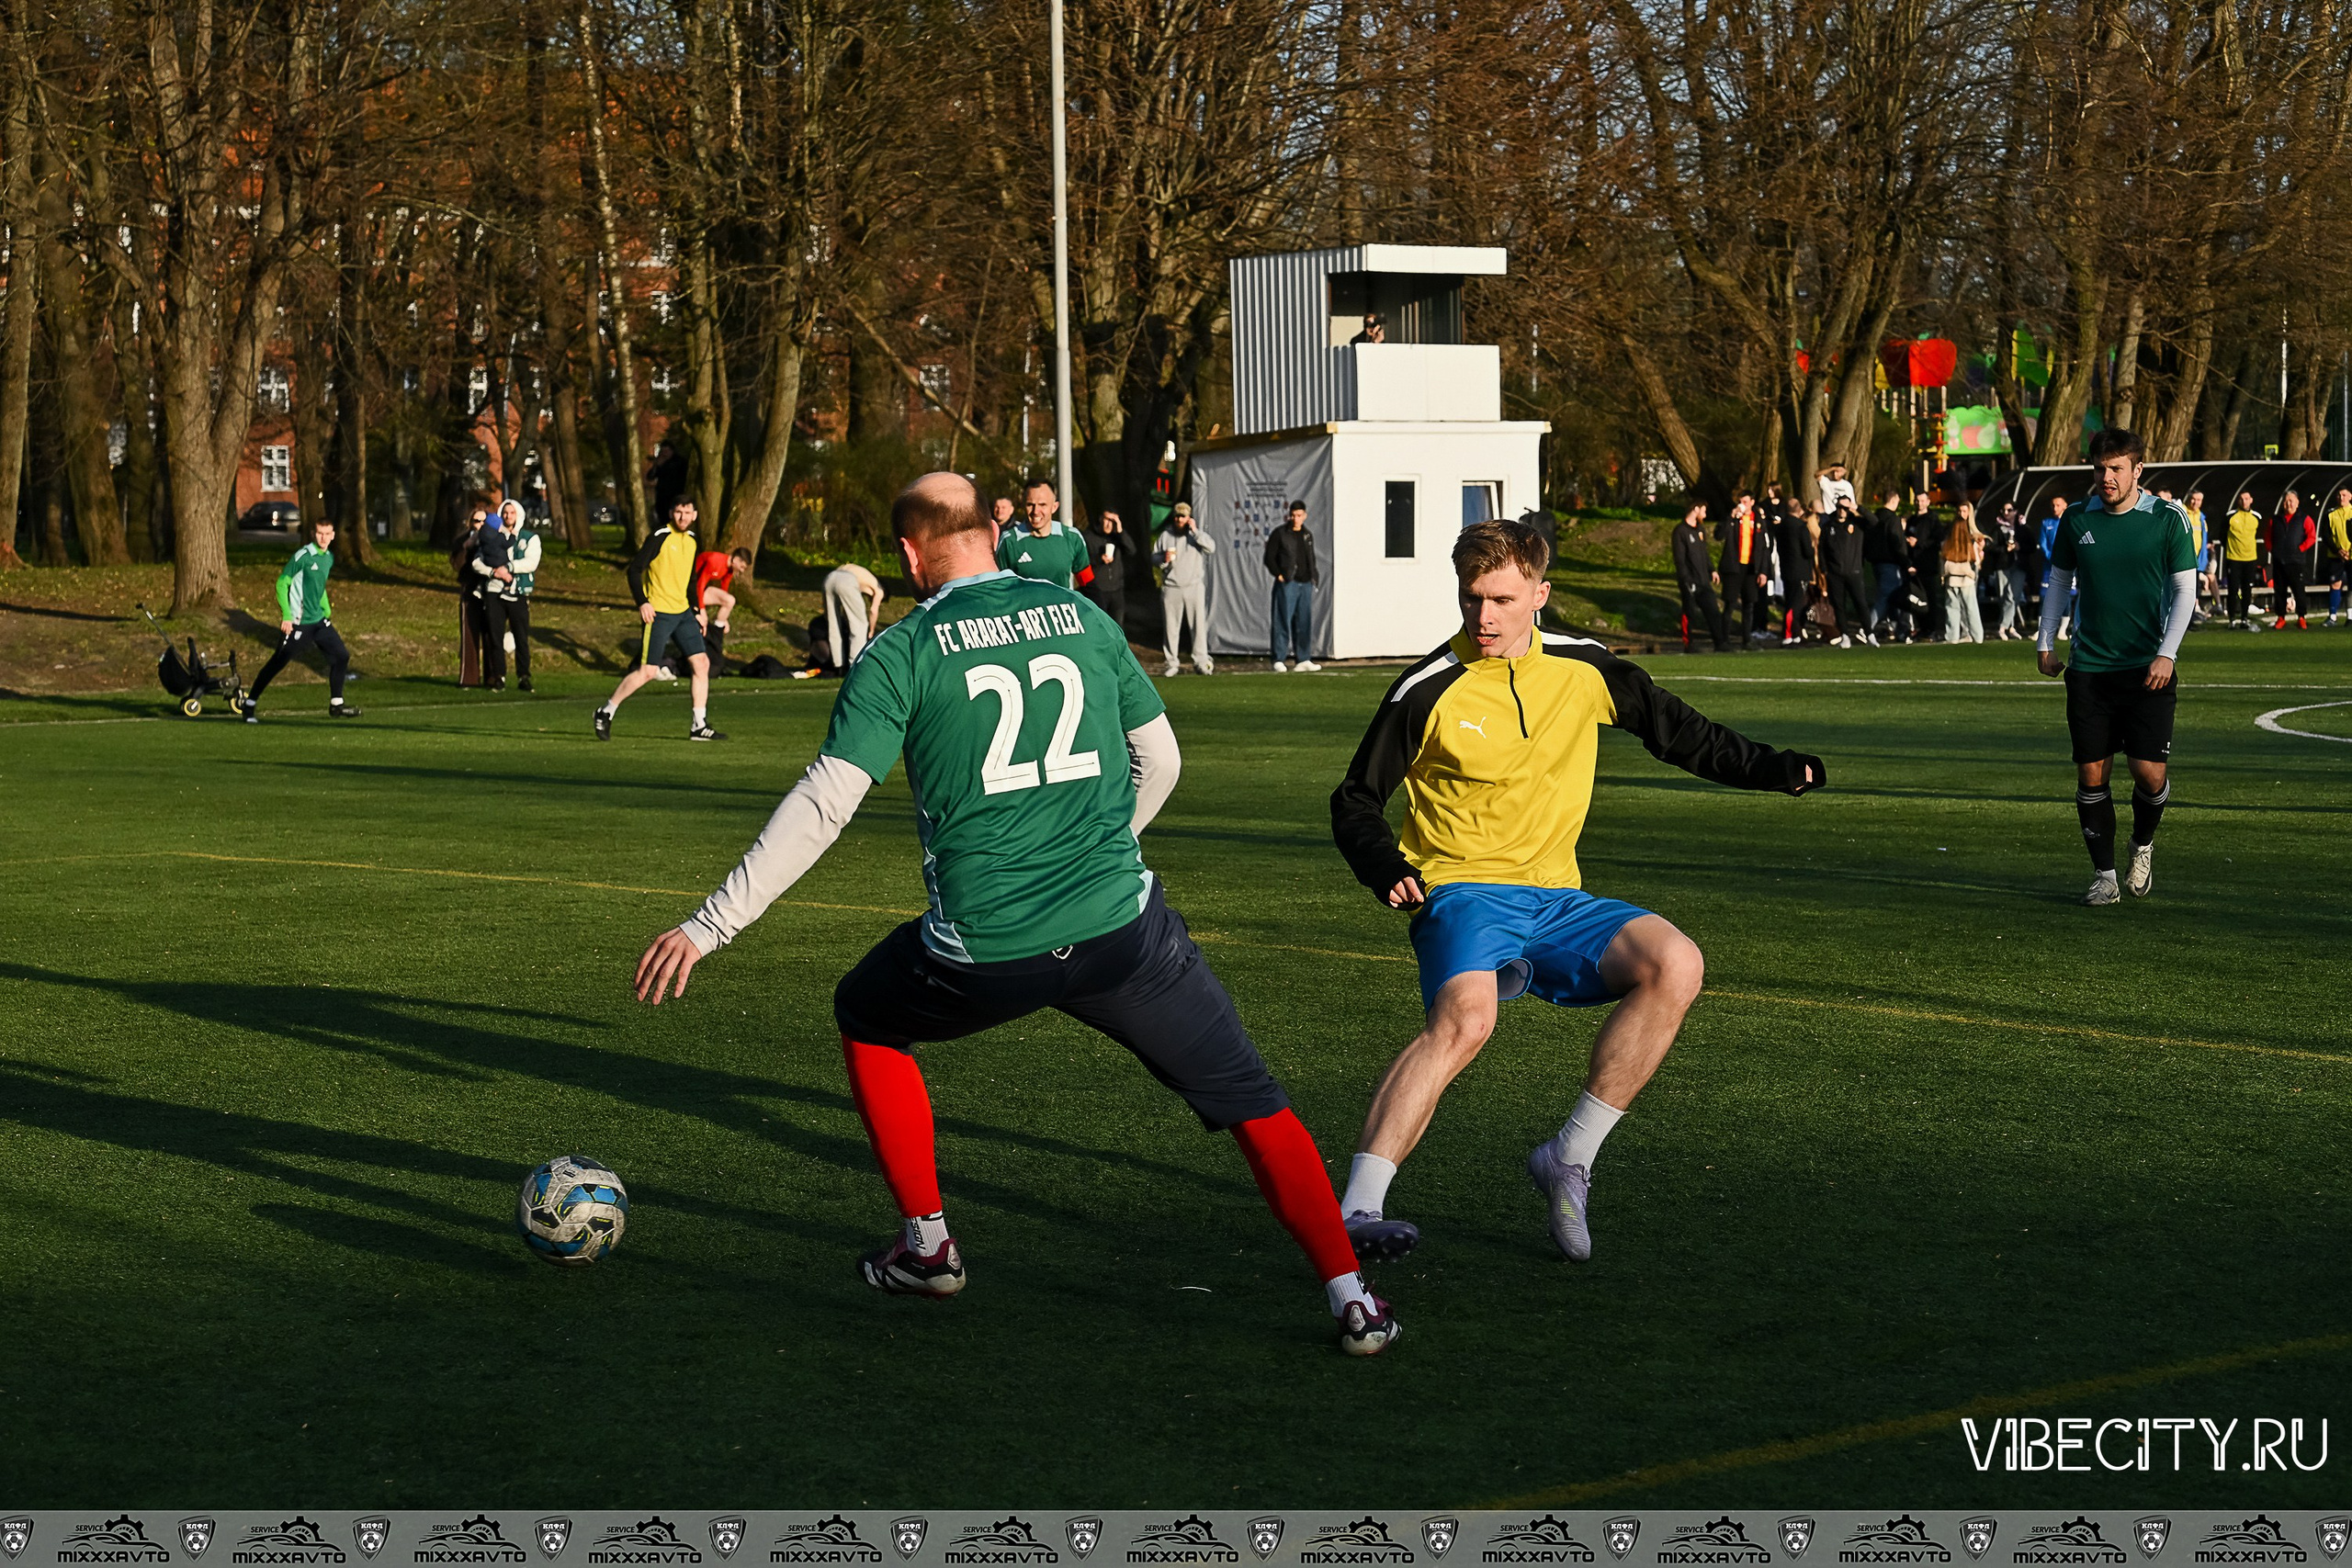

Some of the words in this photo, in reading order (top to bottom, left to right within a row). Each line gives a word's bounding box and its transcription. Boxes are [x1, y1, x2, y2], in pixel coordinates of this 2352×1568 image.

[933, 622, 961, 657] FC
[956, 605, 1052, 651] ARARAT-ART
[1046, 603, 1086, 637] FLEX
[964, 653, 1102, 796] 22
